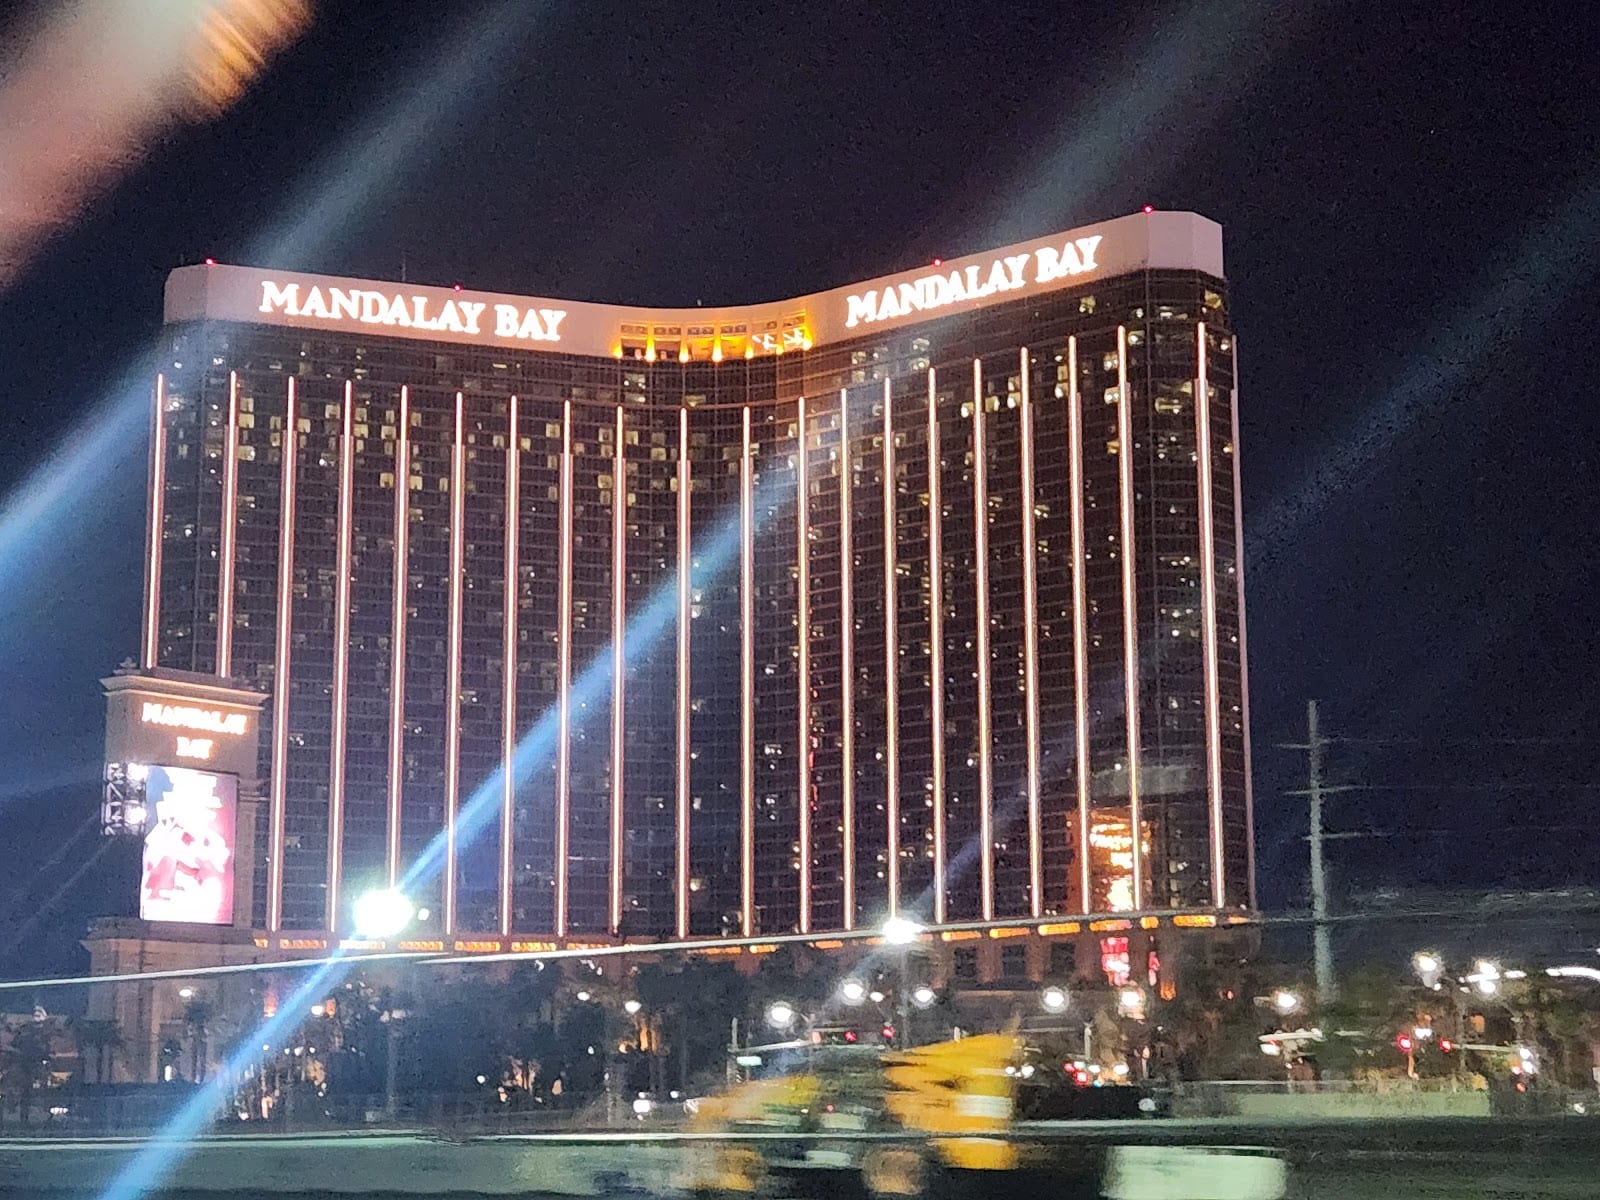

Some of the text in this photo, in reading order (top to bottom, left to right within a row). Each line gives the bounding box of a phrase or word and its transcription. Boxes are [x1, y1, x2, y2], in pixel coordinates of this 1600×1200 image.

[259, 281, 567, 341] MANDALAY BAY
[846, 236, 1102, 327] MANDALAY BAY
